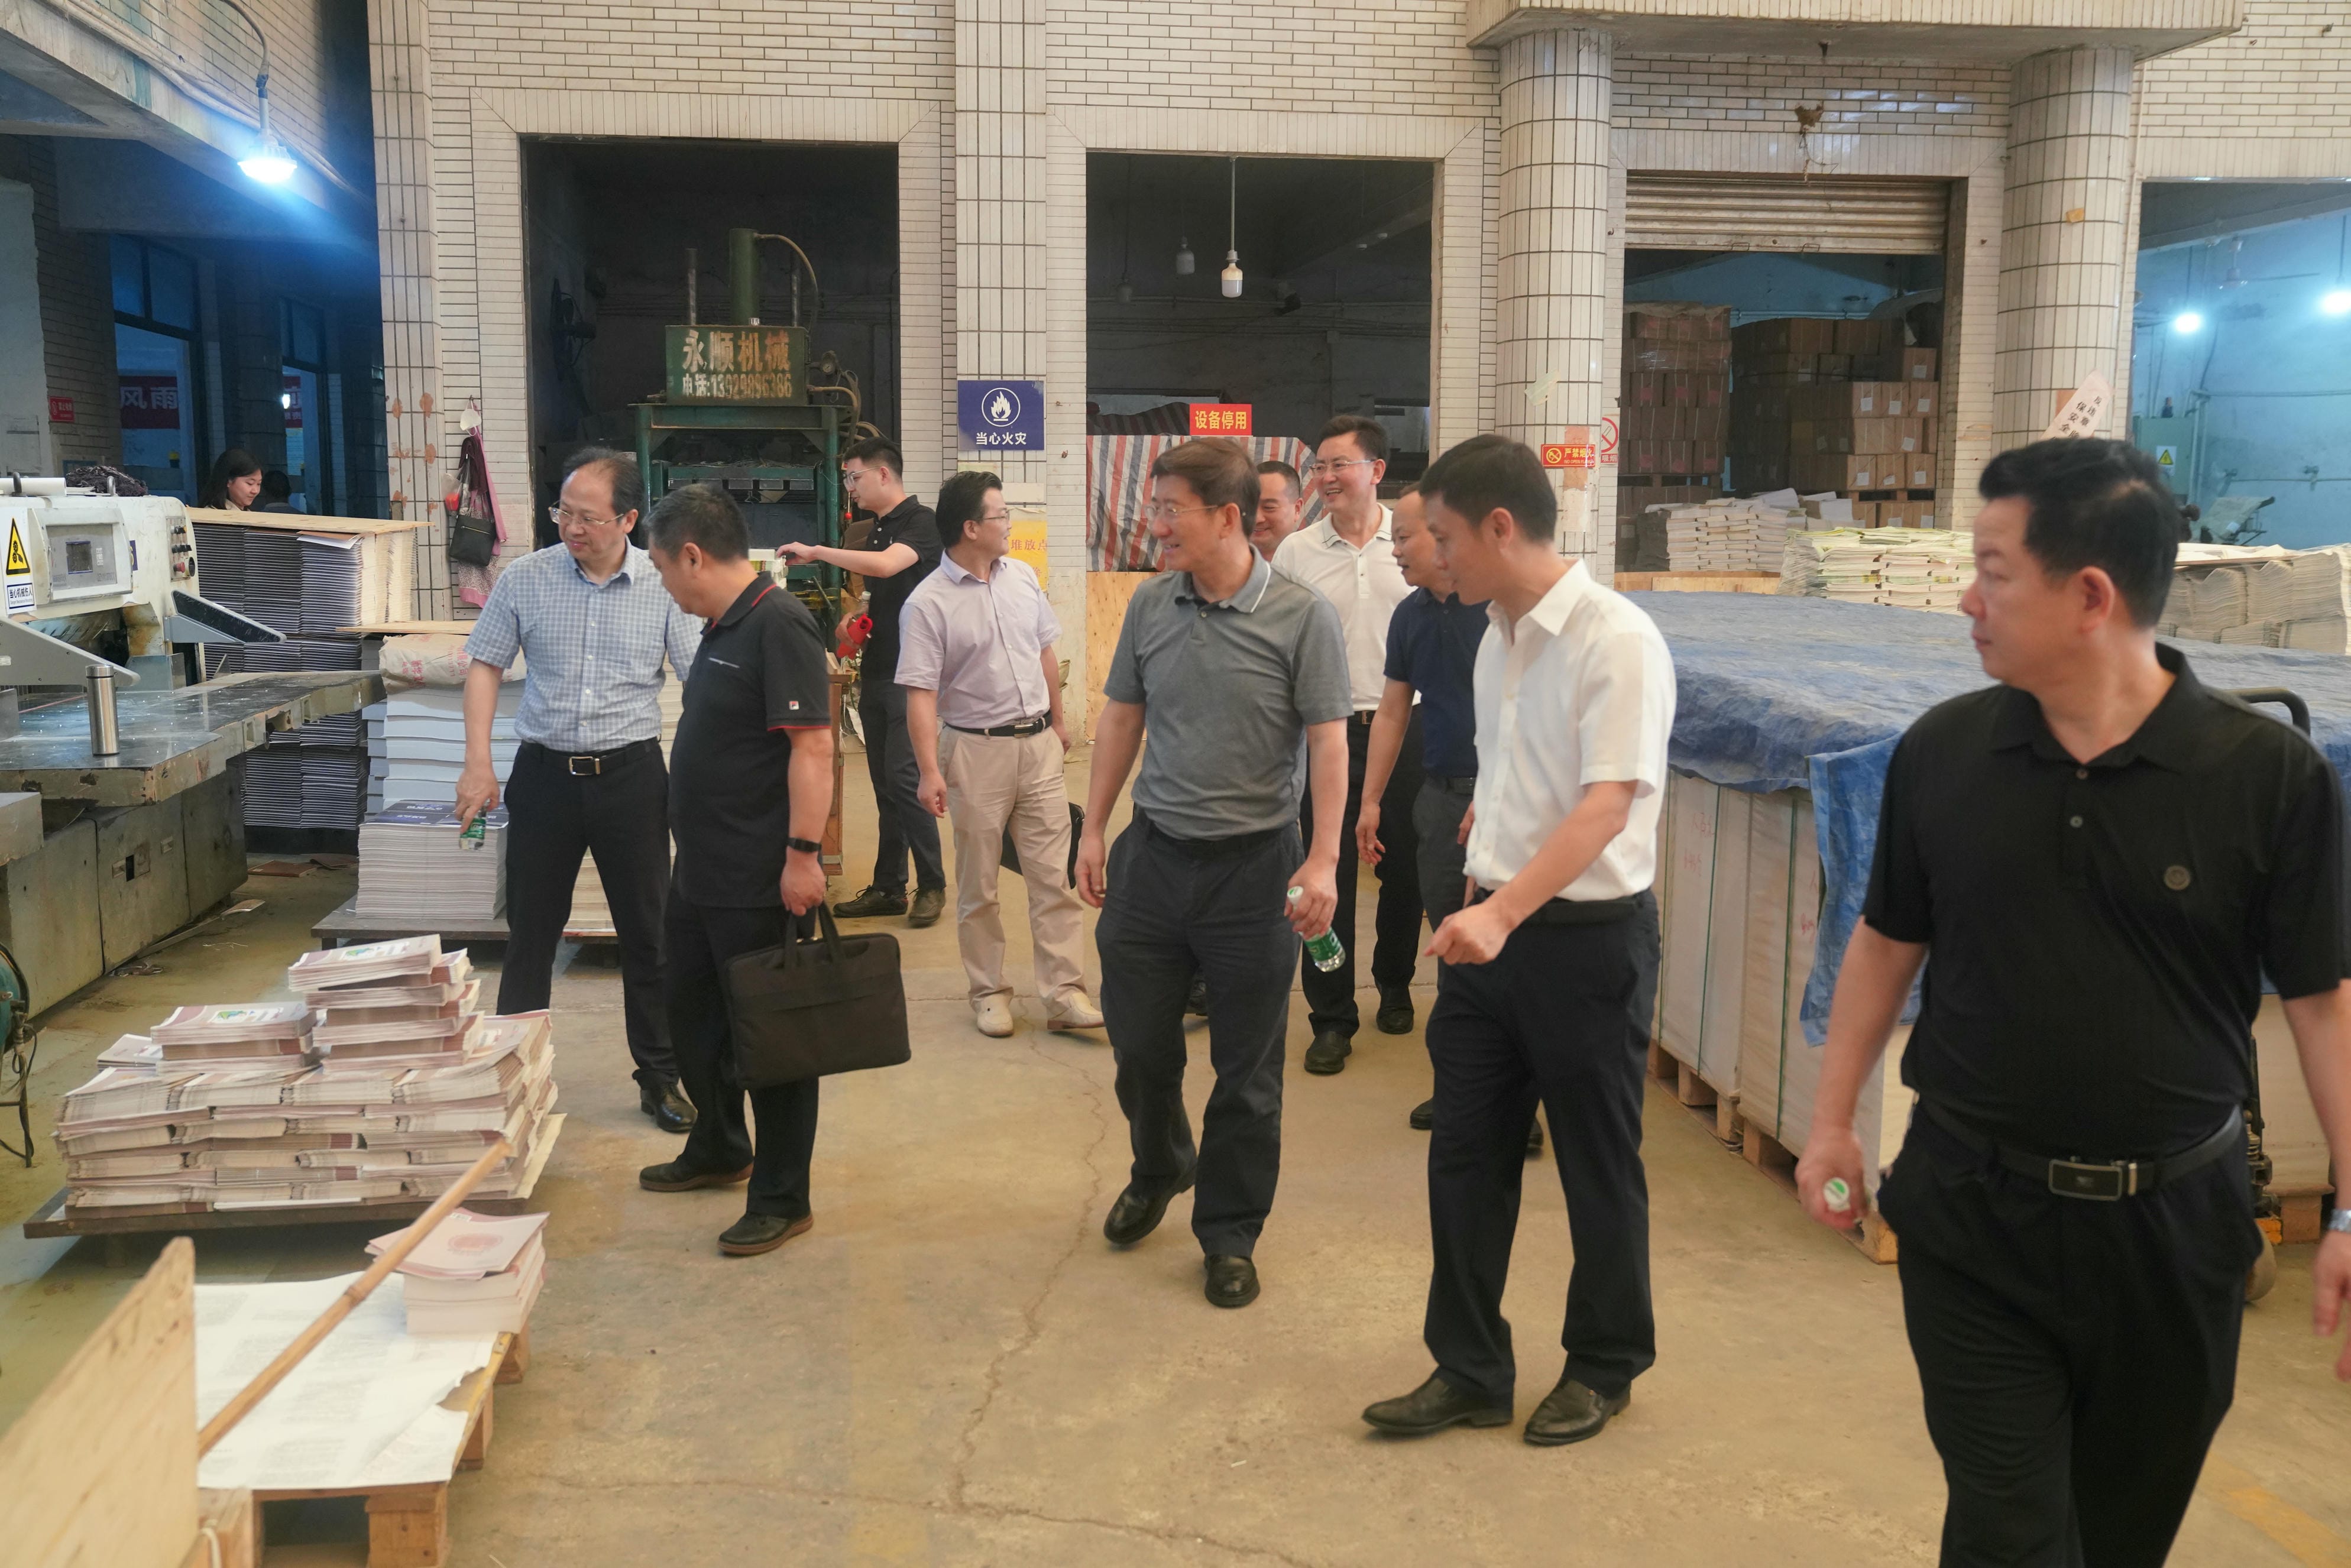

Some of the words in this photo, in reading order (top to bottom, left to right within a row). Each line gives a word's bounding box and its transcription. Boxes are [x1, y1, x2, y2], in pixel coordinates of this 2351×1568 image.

[682, 329, 791, 372] 永顺机械
[1195, 410, 1246, 429] 设备停用
[976, 432, 1027, 446] 当心火灾
[1011, 539, 1047, 551] 堆放点
[9, 586, 33, 598] 当心机械伤人
